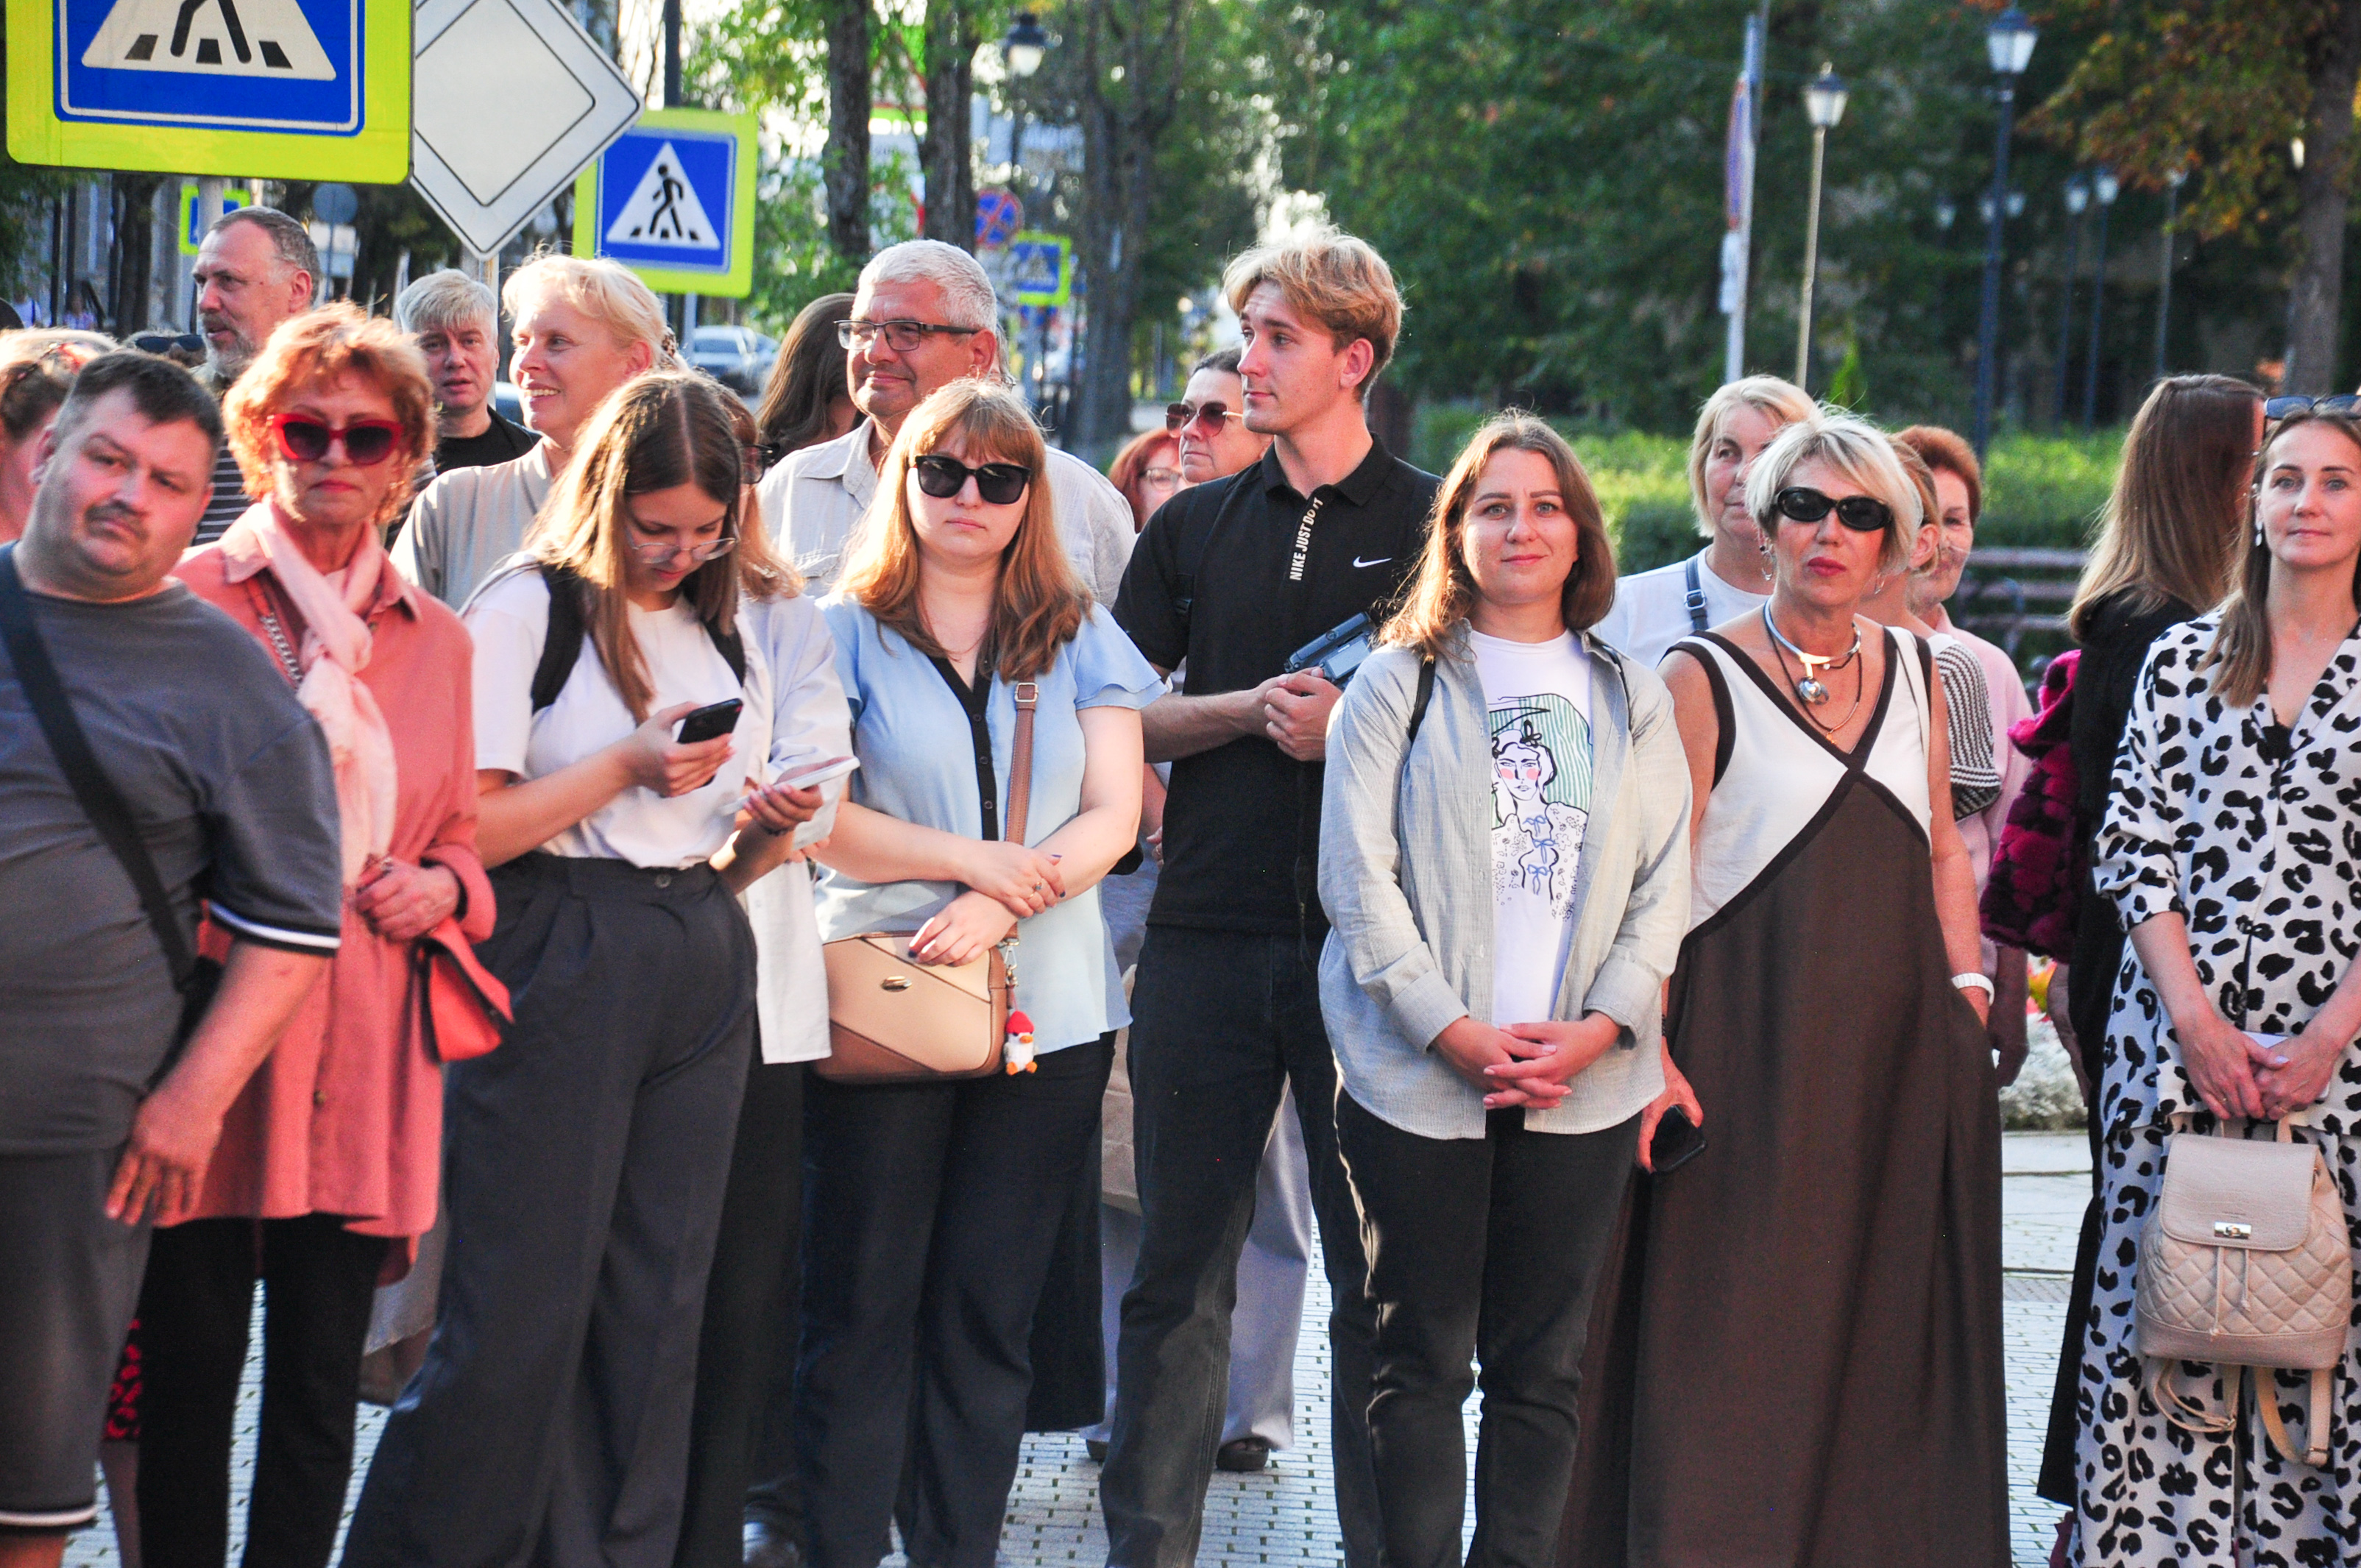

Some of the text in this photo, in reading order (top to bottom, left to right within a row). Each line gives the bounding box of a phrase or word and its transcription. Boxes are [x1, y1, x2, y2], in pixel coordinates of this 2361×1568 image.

[1303, 508, 1316, 525] DO
[1295, 523, 1312, 552] JUST
[1289, 552, 1306, 581] NIKE
